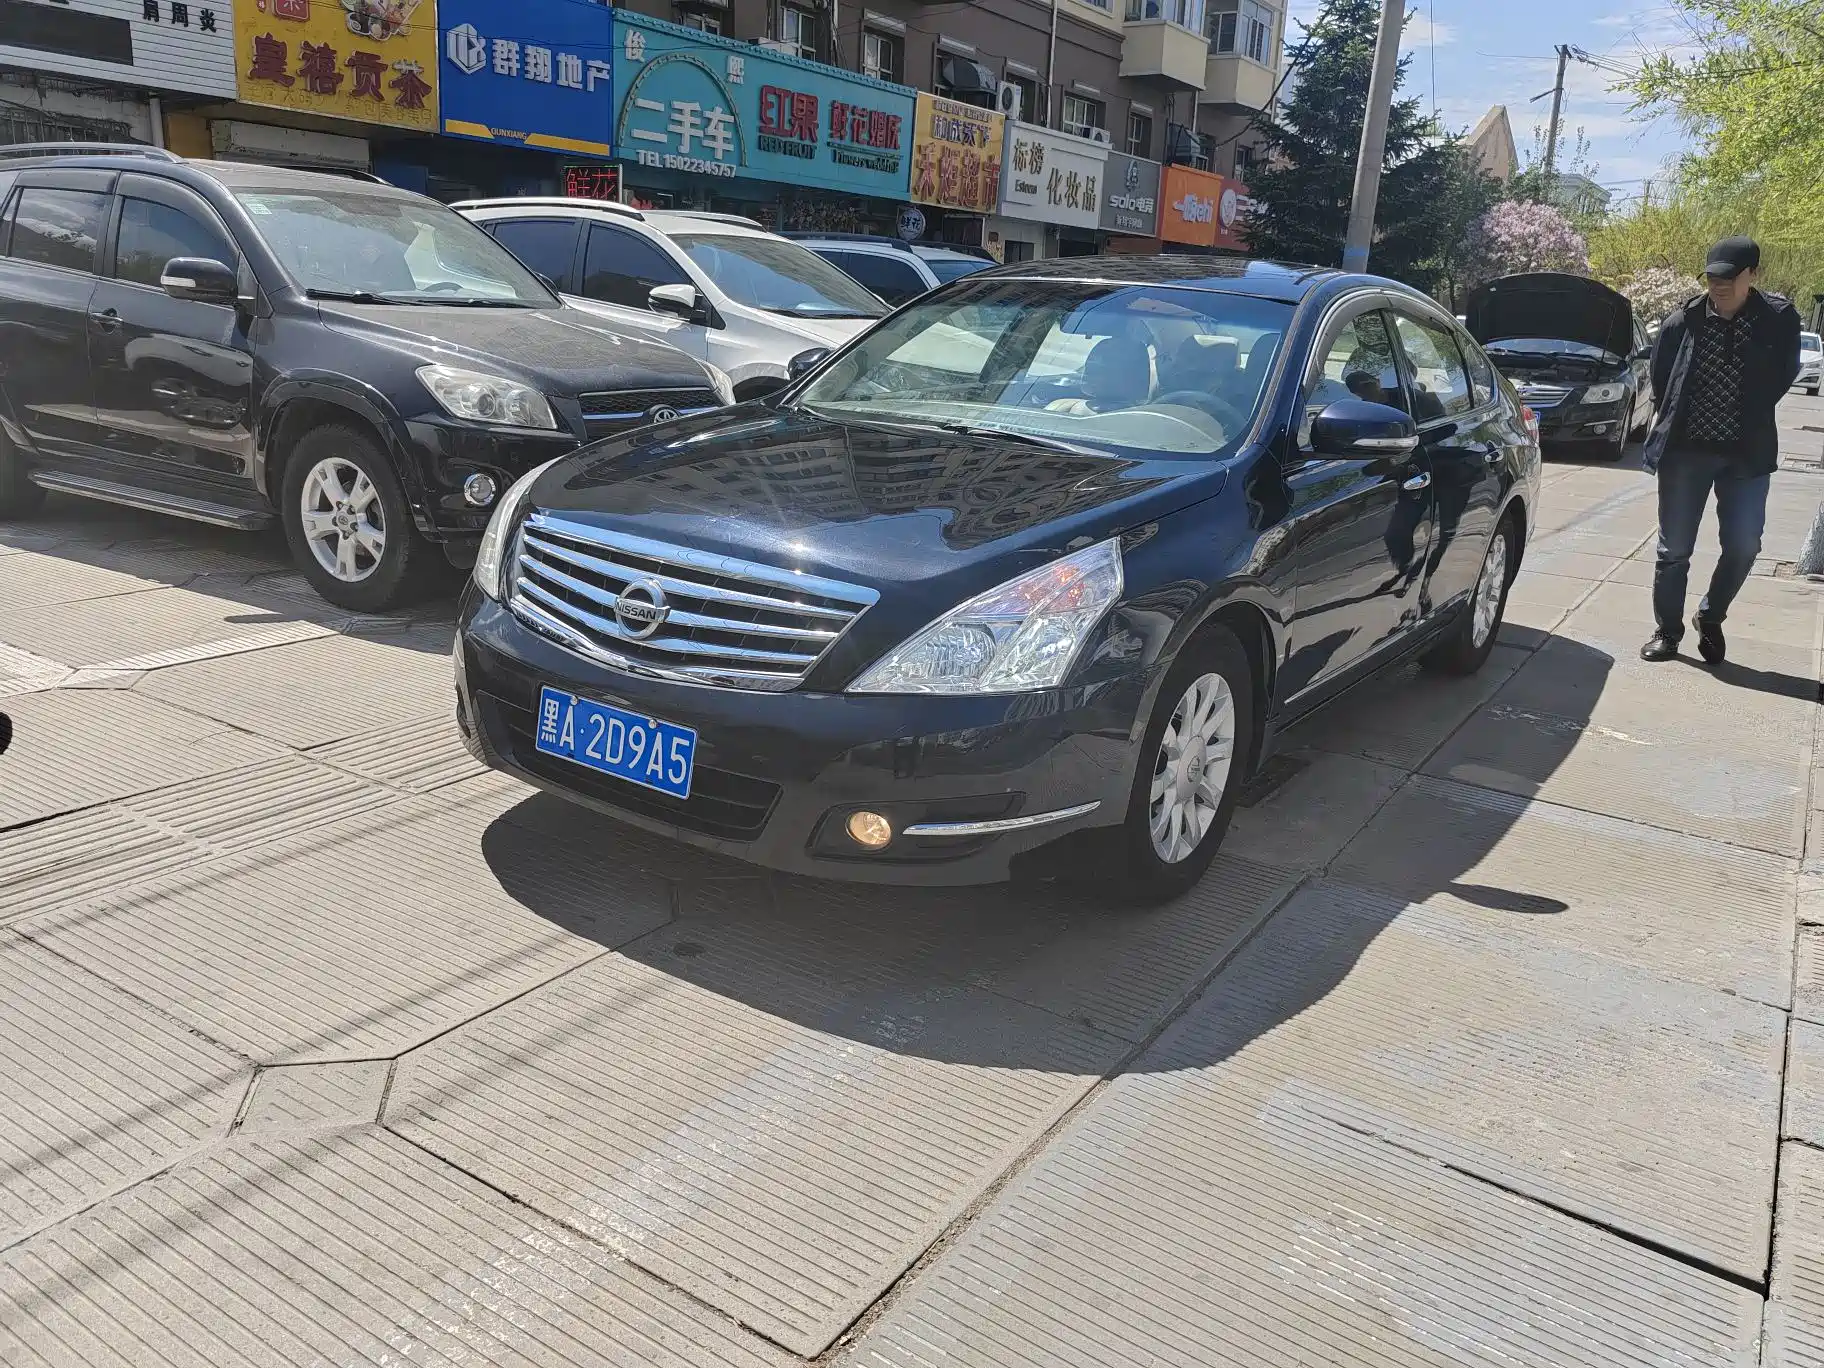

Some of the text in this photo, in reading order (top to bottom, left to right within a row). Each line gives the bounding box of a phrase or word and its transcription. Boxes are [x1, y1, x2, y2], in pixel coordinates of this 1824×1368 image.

[492, 39, 610, 92] 群翔地产
[631, 97, 735, 160] 二手车
[758, 84, 819, 143] 红果
[830, 100, 903, 150] 鲜花婚庆
[636, 149, 736, 178] TEL 15022345757
[758, 135, 817, 160] RED FRUIT
[566, 168, 618, 200] 鲜花
[1046, 167, 1096, 213] 化妆品
[616, 601, 657, 621] NISSAN
[541, 696, 691, 785] 黑A·2D9A5
